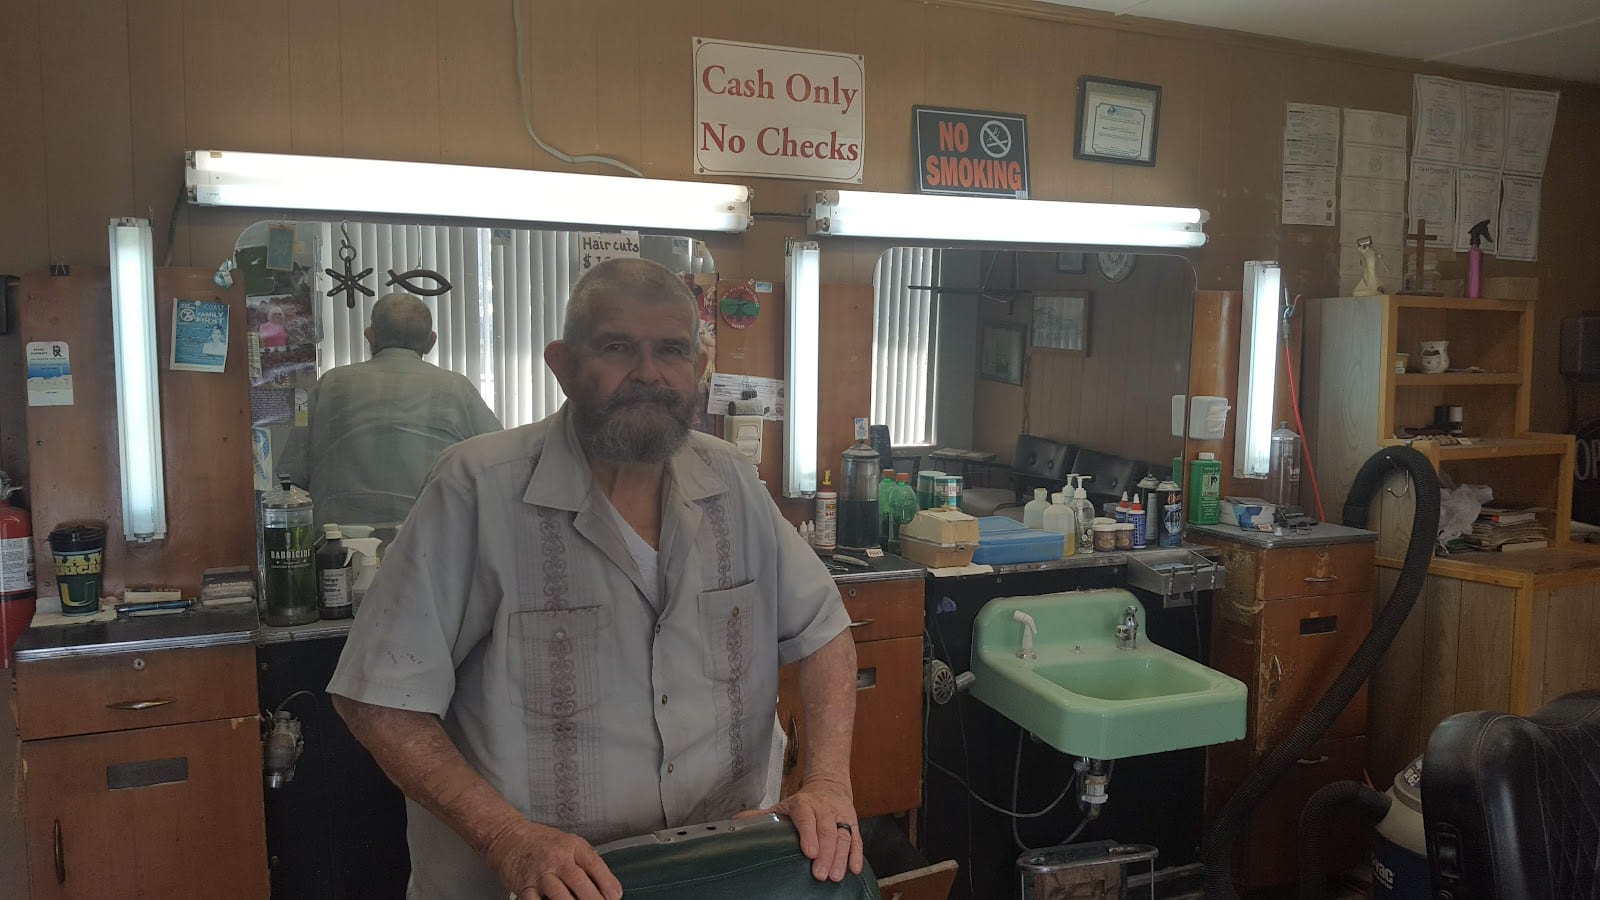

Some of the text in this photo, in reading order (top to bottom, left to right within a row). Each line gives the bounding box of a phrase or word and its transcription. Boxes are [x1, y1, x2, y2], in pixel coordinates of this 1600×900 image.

[702, 65, 859, 115] Cash Only
[700, 121, 859, 161] No Checks
[938, 120, 969, 153] NO
[926, 155, 1022, 191] SMOKING
